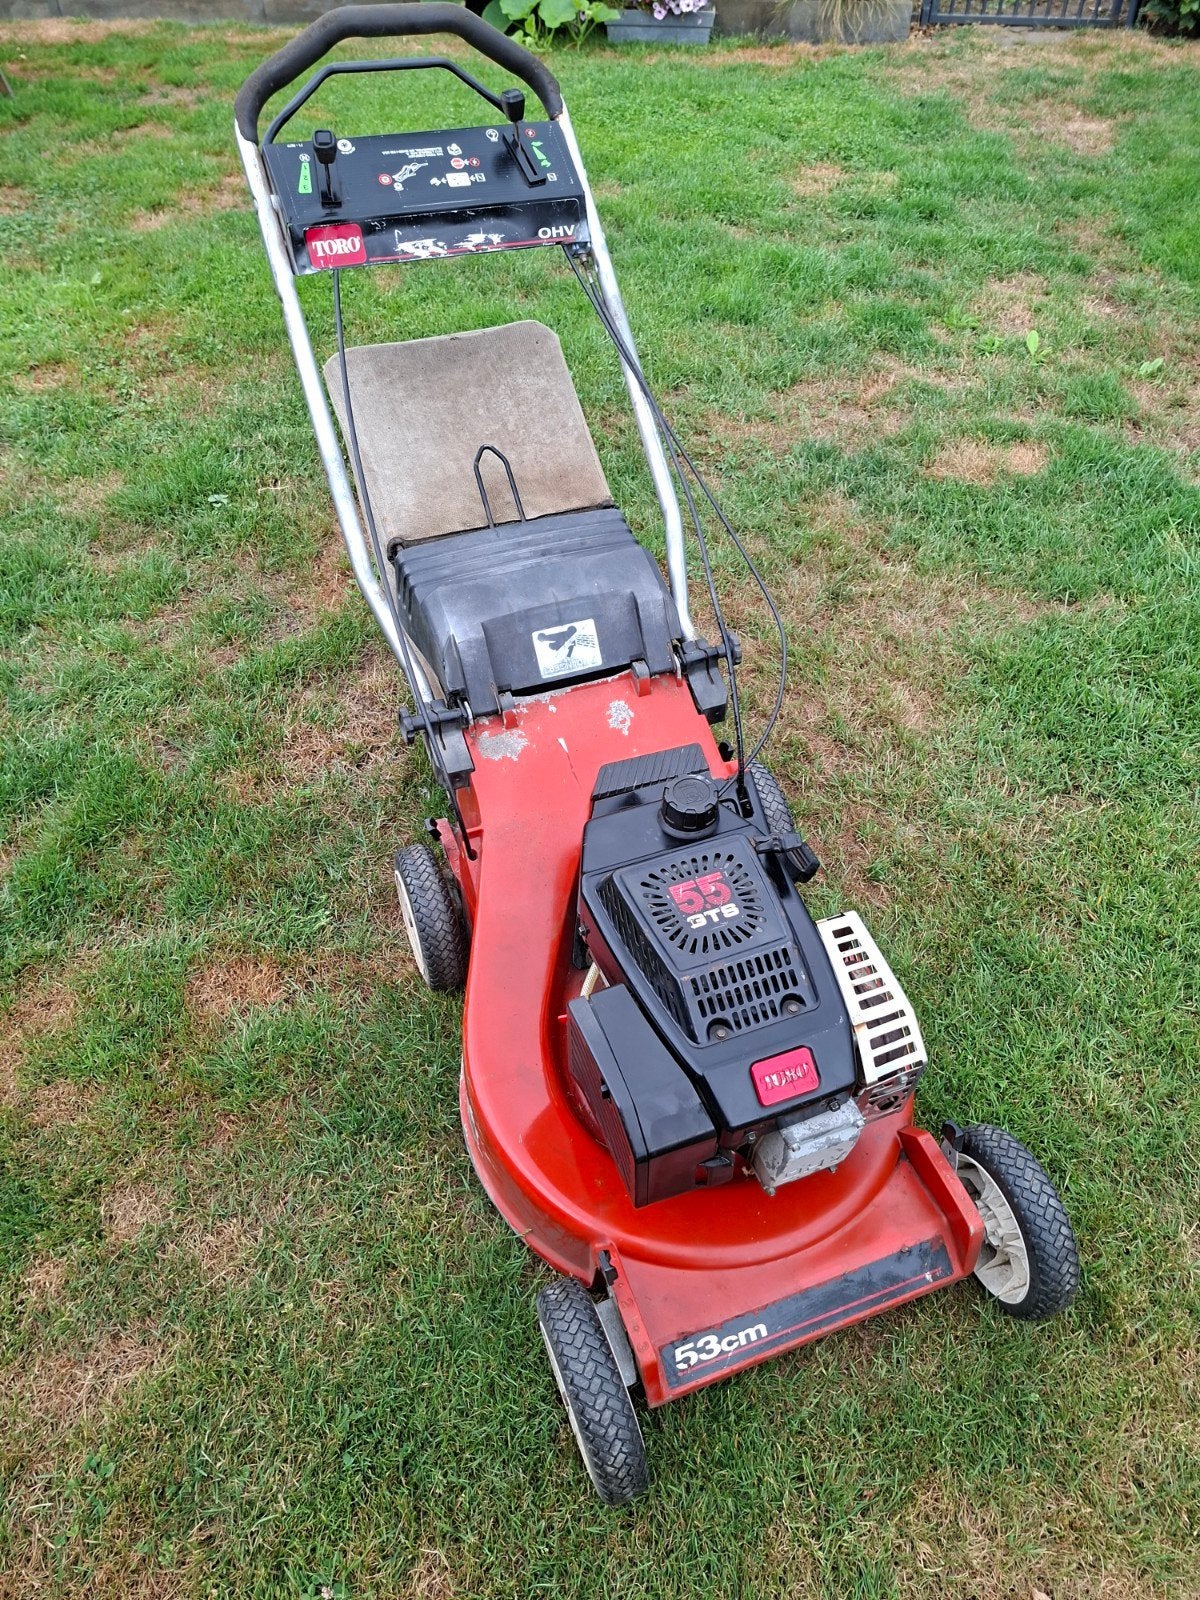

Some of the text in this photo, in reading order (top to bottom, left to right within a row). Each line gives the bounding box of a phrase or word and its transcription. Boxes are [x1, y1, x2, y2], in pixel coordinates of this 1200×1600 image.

[538, 225, 575, 239] OHV
[311, 236, 361, 257] TORO
[687, 903, 740, 930] GTS
[673, 1323, 769, 1370] 53cm
